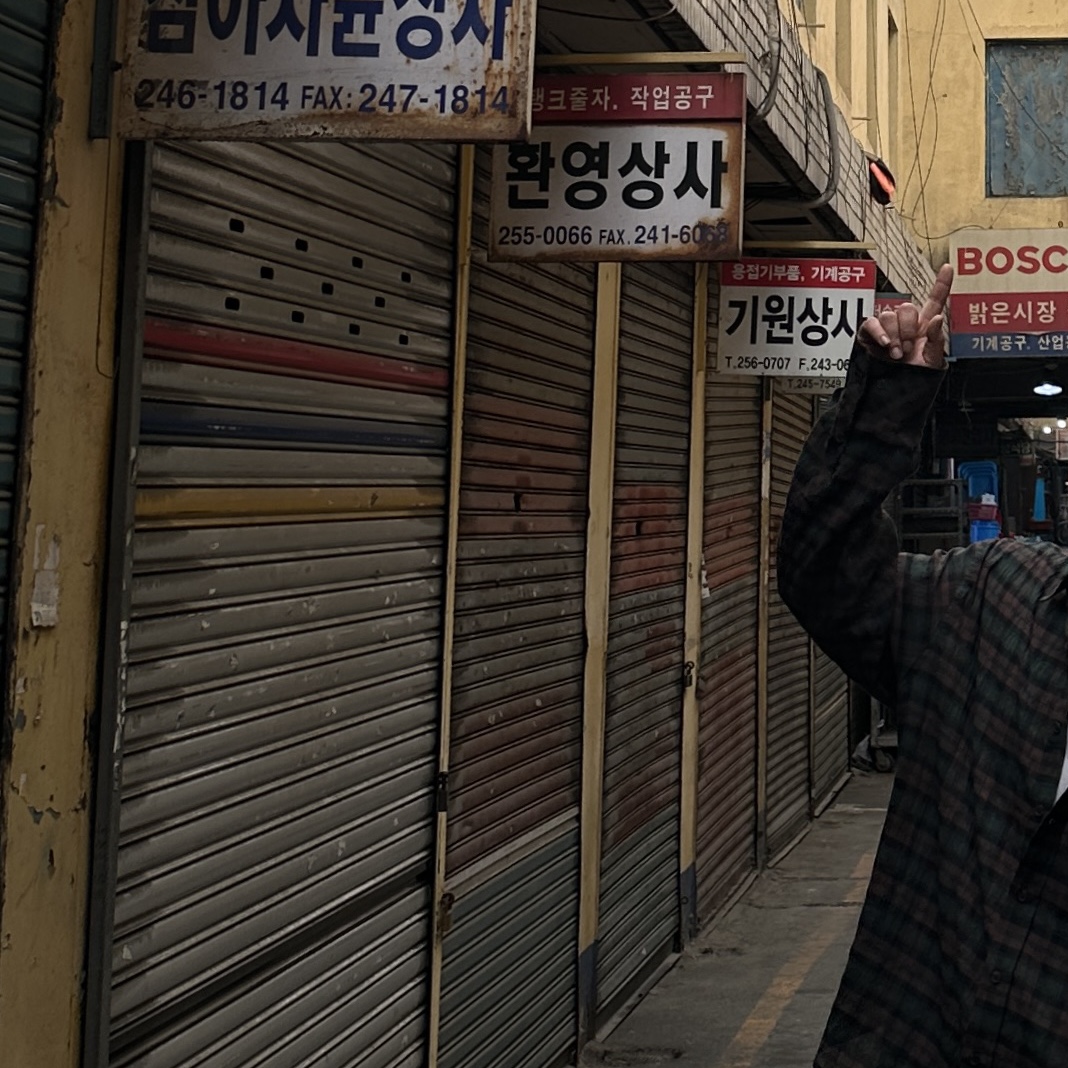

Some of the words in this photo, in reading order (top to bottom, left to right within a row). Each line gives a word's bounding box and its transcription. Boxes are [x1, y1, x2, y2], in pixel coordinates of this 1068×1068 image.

[135, 79, 289, 110] 246-1814
[359, 83, 509, 115] 247-1814
[631, 85, 714, 110] 작업공구
[506, 140, 729, 210] 환영상사
[499, 226, 593, 245] 255-0066
[811, 266, 866, 283] 기계공구
[968, 301, 1057, 325] 밝은시장
